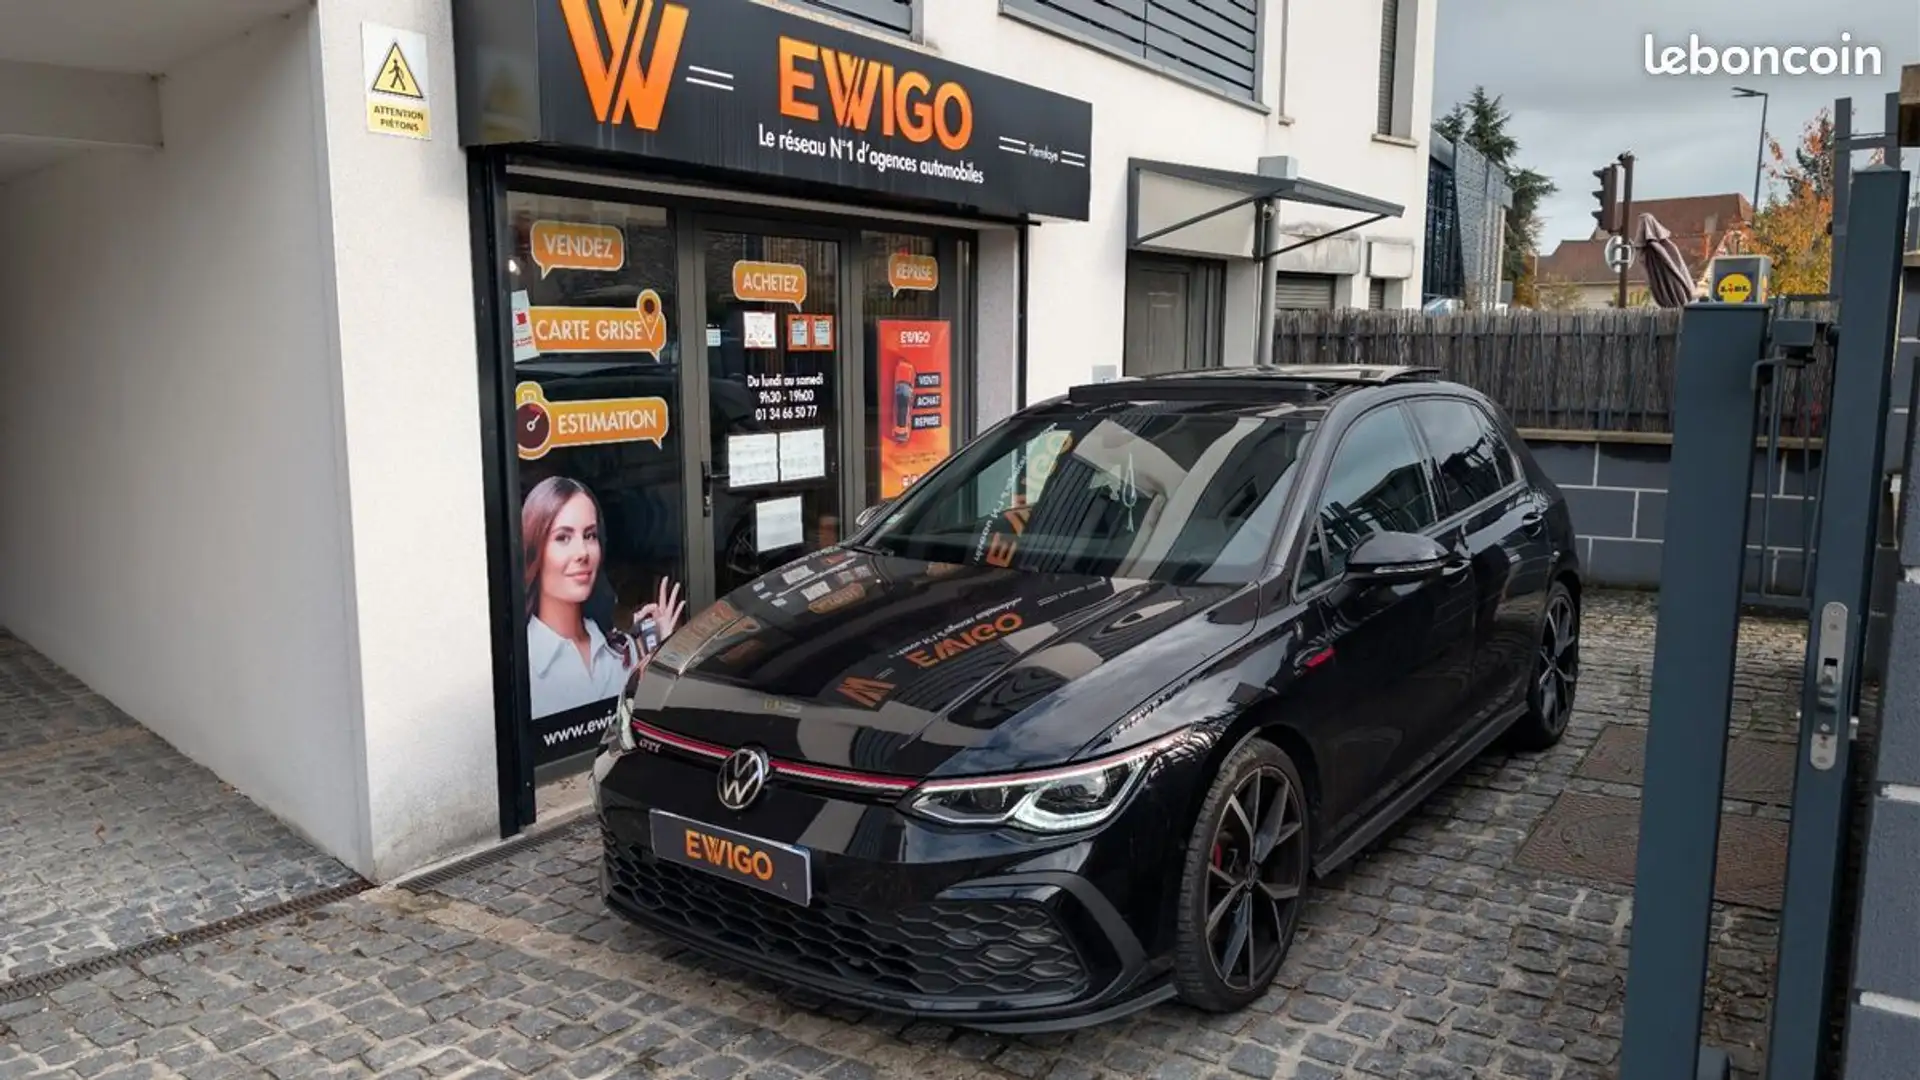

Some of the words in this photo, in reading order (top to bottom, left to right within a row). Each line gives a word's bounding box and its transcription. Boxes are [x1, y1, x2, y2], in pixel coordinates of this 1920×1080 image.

[778, 34, 974, 151] EWIGO
[373, 105, 425, 121] ATTENTION
[758, 123, 776, 147] Le
[779, 129, 826, 157] réseau
[920, 159, 985, 185] automobiles
[542, 233, 614, 259] VENDEZ
[895, 263, 933, 282] REPRISE
[741, 273, 800, 293] ACHETEZ
[535, 319, 591, 341] CARTE
[595, 319, 643, 341] GRISE
[900, 330, 931, 344] EWIGO
[747, 374, 760, 387] Du
[761, 373, 782, 387] lundi
[784, 376, 795, 386] au
[795, 372, 824, 386] samedi
[759, 390, 782, 404] 9h30
[788, 388, 815, 402] 19h00
[916, 395, 940, 407] ACHAT
[557, 408, 658, 435] ESTIMATION
[755, 407, 767, 421] 01
[768, 407, 781, 420] 34
[782, 406, 794, 419] 66
[794, 405, 806, 419] 50
[807, 404, 818, 418] 77
[638, 737, 663, 754] GTI
[684, 827, 775, 882] EWIGO
